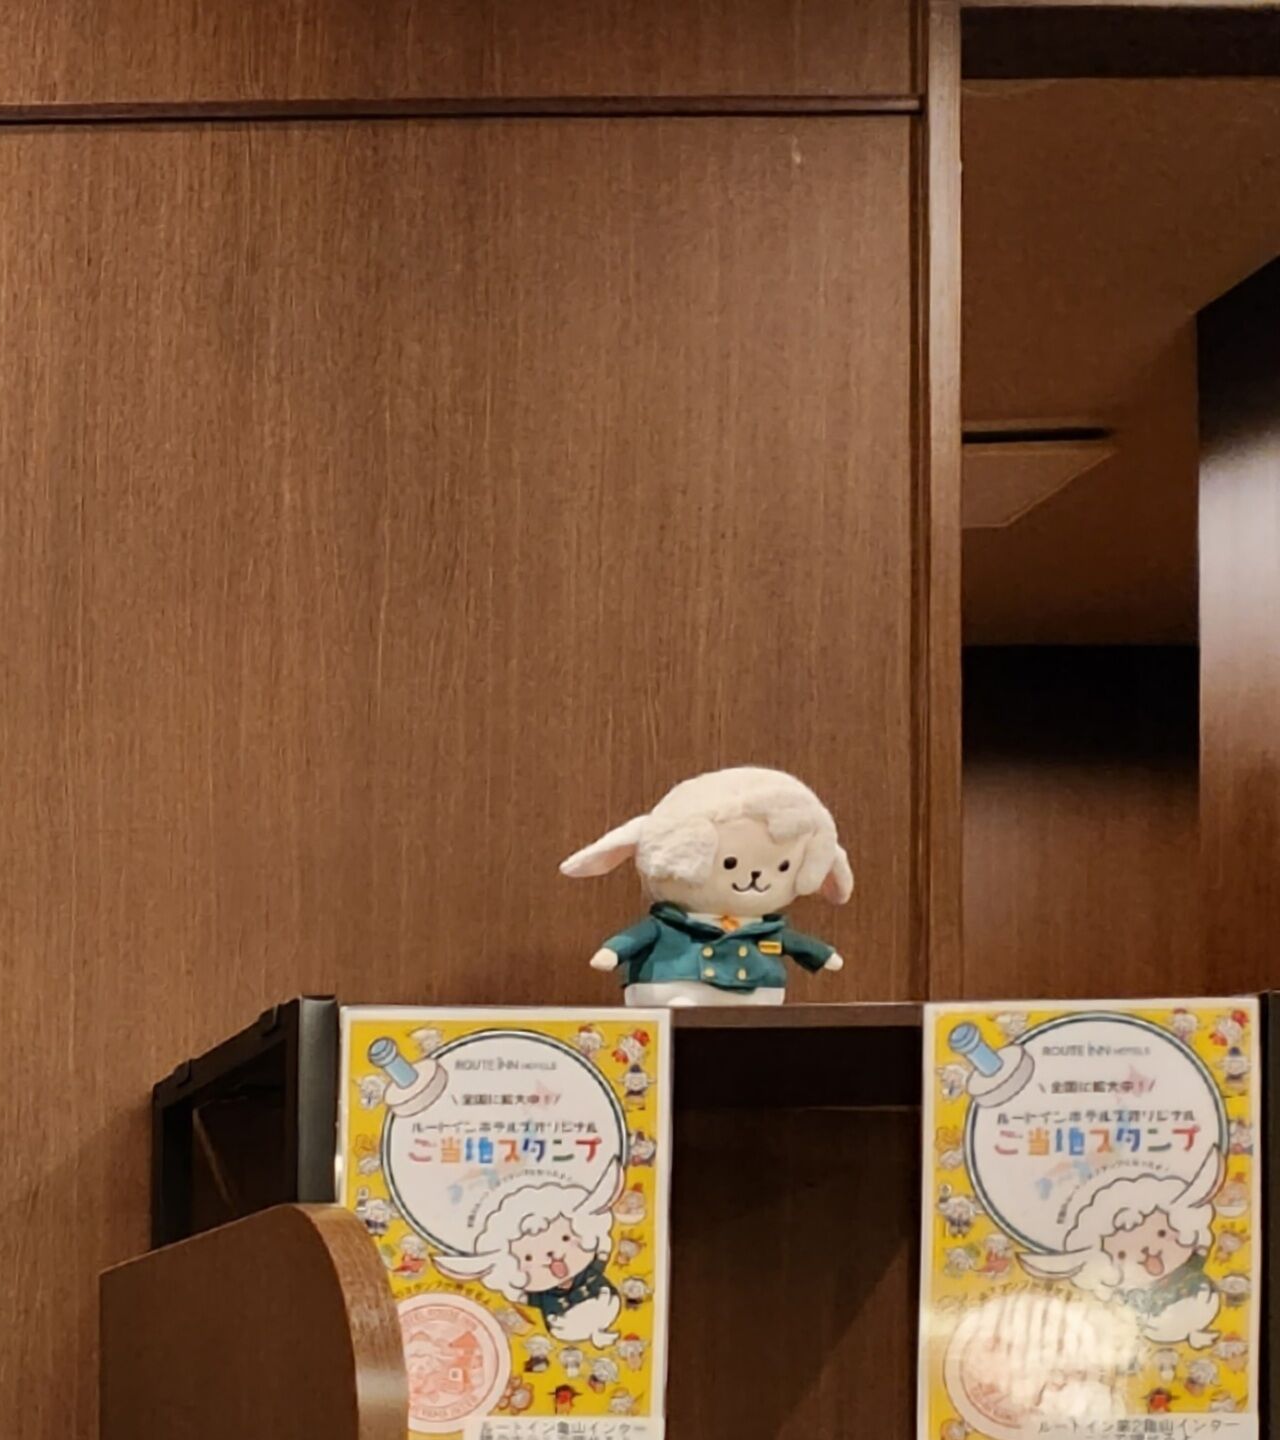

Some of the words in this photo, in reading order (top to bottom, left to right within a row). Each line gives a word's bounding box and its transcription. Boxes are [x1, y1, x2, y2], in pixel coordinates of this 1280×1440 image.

[408, 1136, 603, 1164] ご当地スタンプ
[994, 1124, 1201, 1157] ご当地スタンプ
